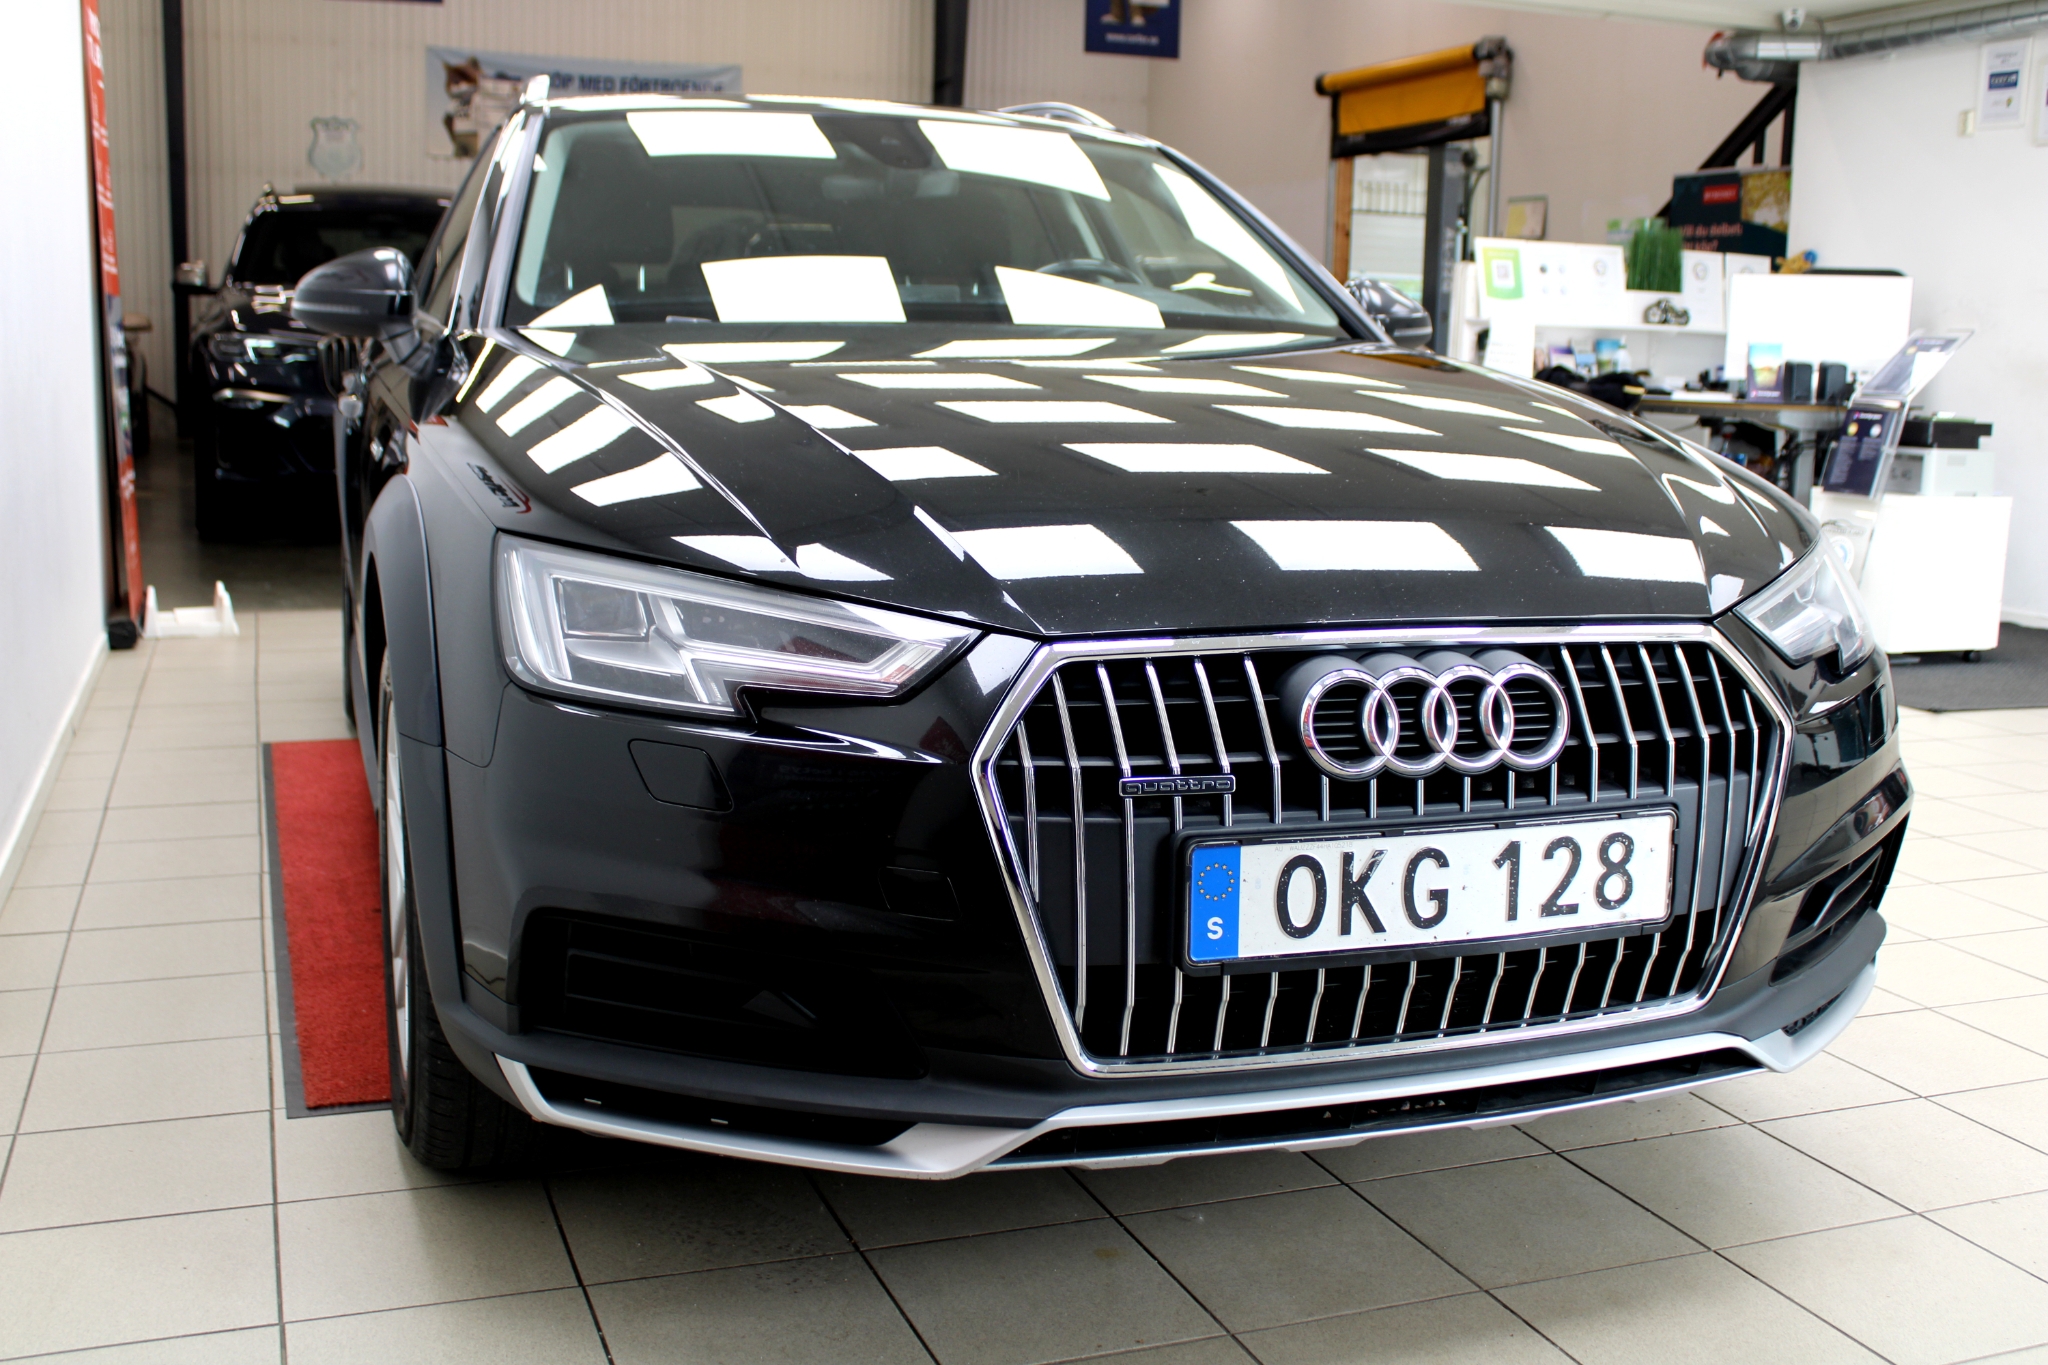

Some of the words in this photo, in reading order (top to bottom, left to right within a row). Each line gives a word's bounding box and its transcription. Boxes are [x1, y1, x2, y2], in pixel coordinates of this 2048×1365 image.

[550, 72, 573, 89] ÖP
[578, 74, 615, 92] MED
[1126, 780, 1231, 794] quattro
[1276, 846, 1450, 940] OKG
[1491, 831, 1635, 922] 128
[1206, 916, 1224, 940] S
